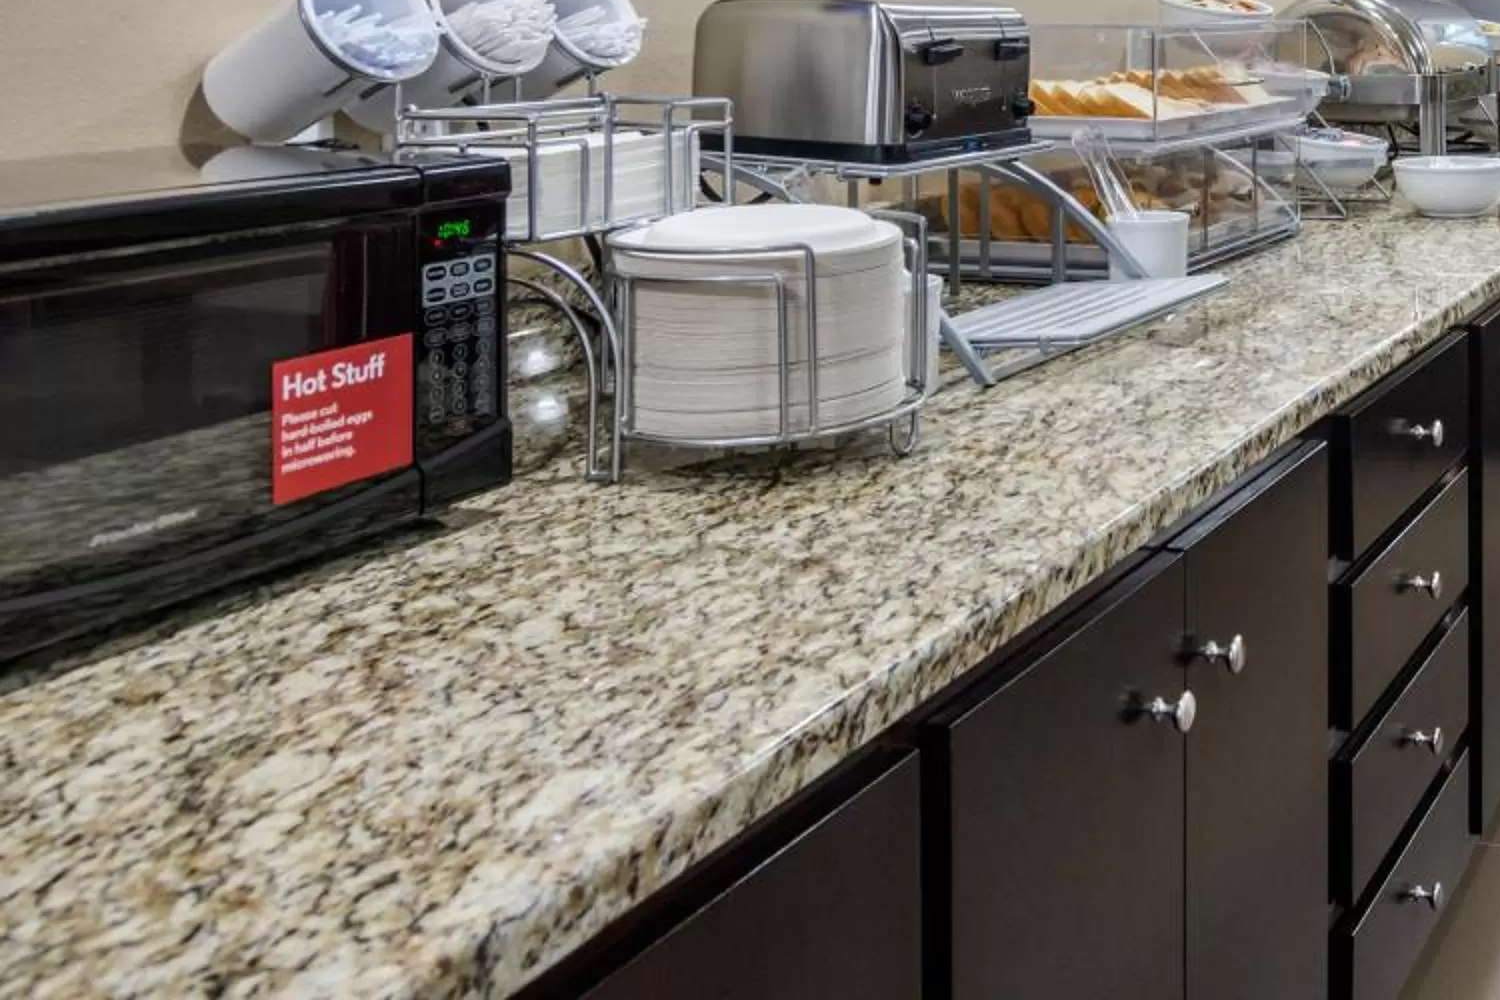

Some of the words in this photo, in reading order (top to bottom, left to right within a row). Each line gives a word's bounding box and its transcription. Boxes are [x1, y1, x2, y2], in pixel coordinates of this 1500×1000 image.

[282, 368, 327, 400] Hot
[331, 352, 385, 389] Stuff
[282, 409, 318, 427] Please
